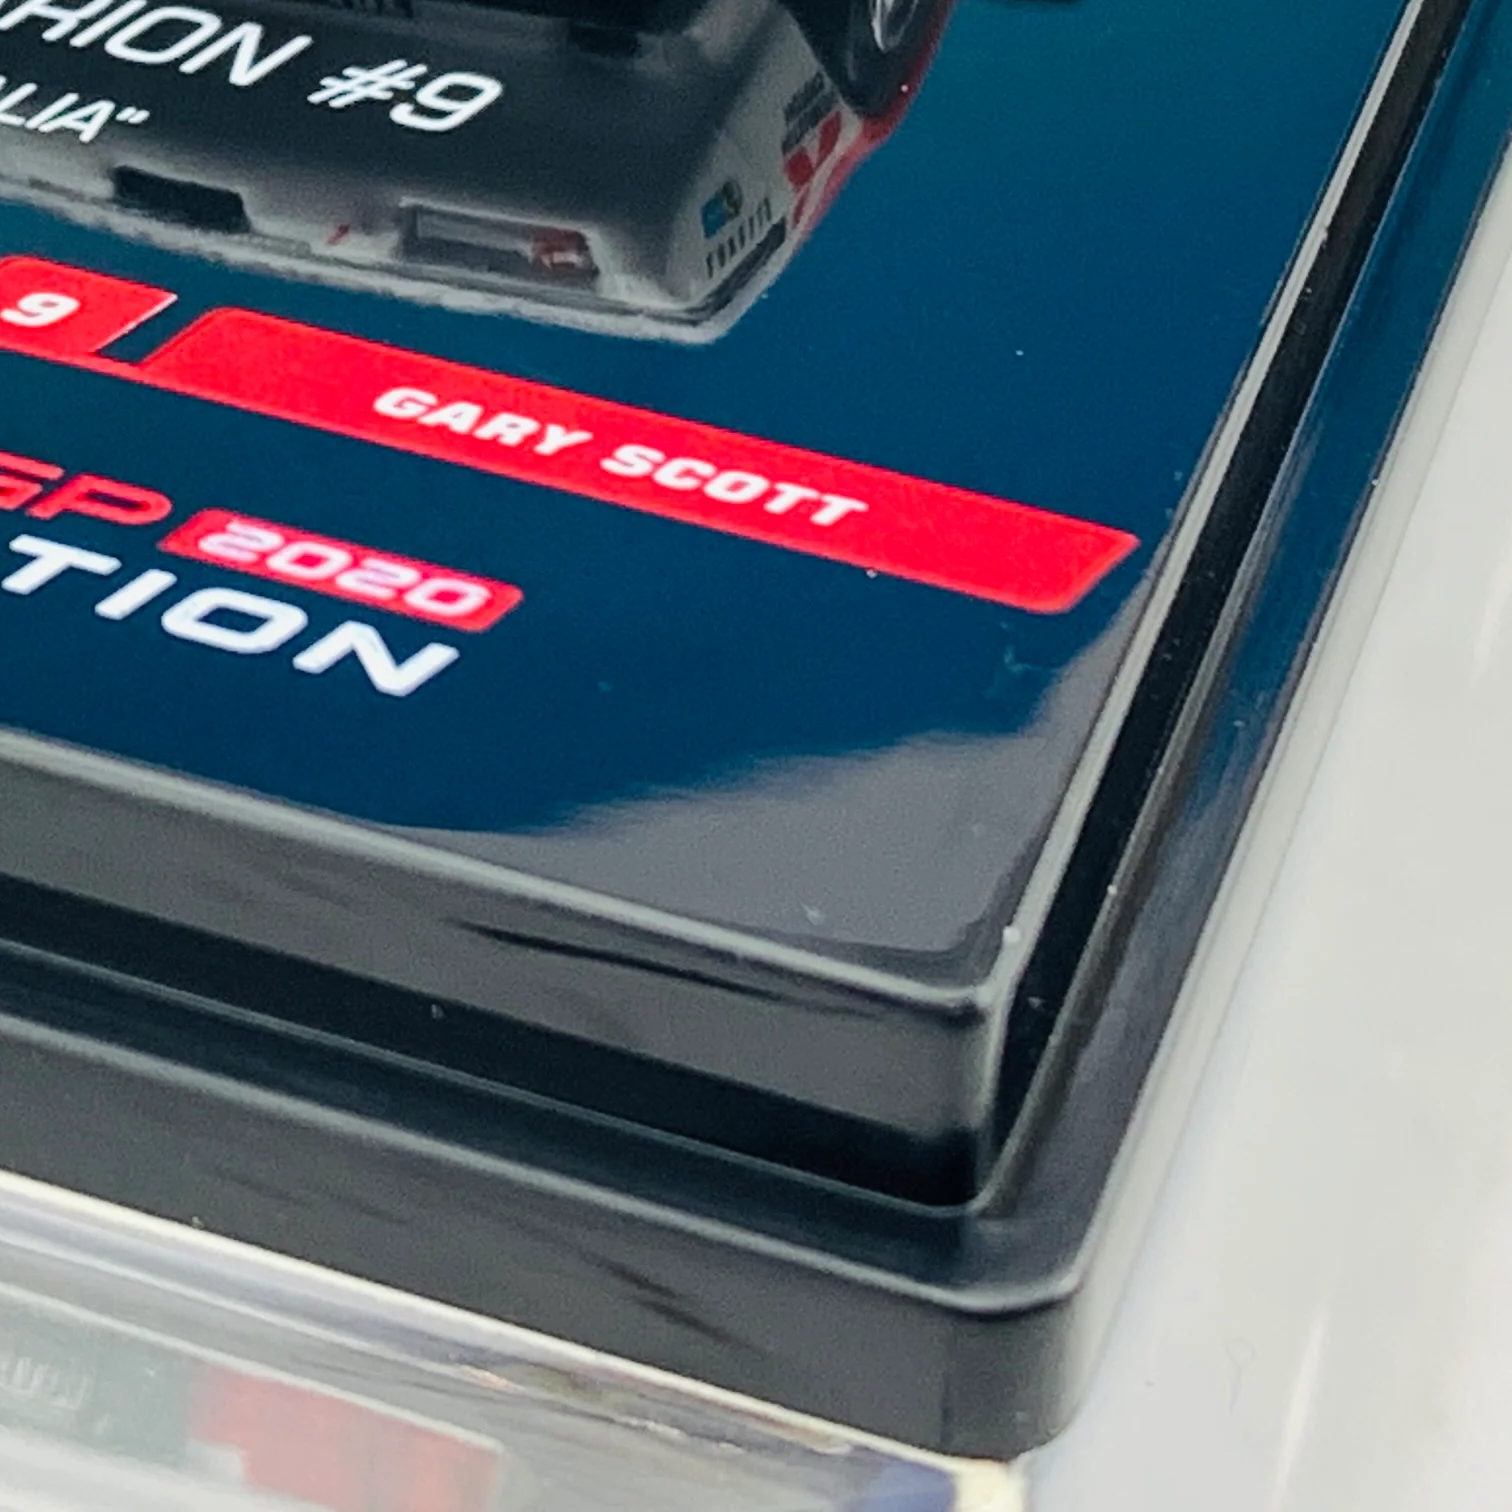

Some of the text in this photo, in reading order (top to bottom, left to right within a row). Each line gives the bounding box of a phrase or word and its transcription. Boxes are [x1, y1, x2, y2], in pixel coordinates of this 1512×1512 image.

[307, 58, 503, 133] #9
[0, 291, 80, 328] 9
[373, 386, 871, 528] GARY SCOTT
[197, 518, 494, 618] 2020
